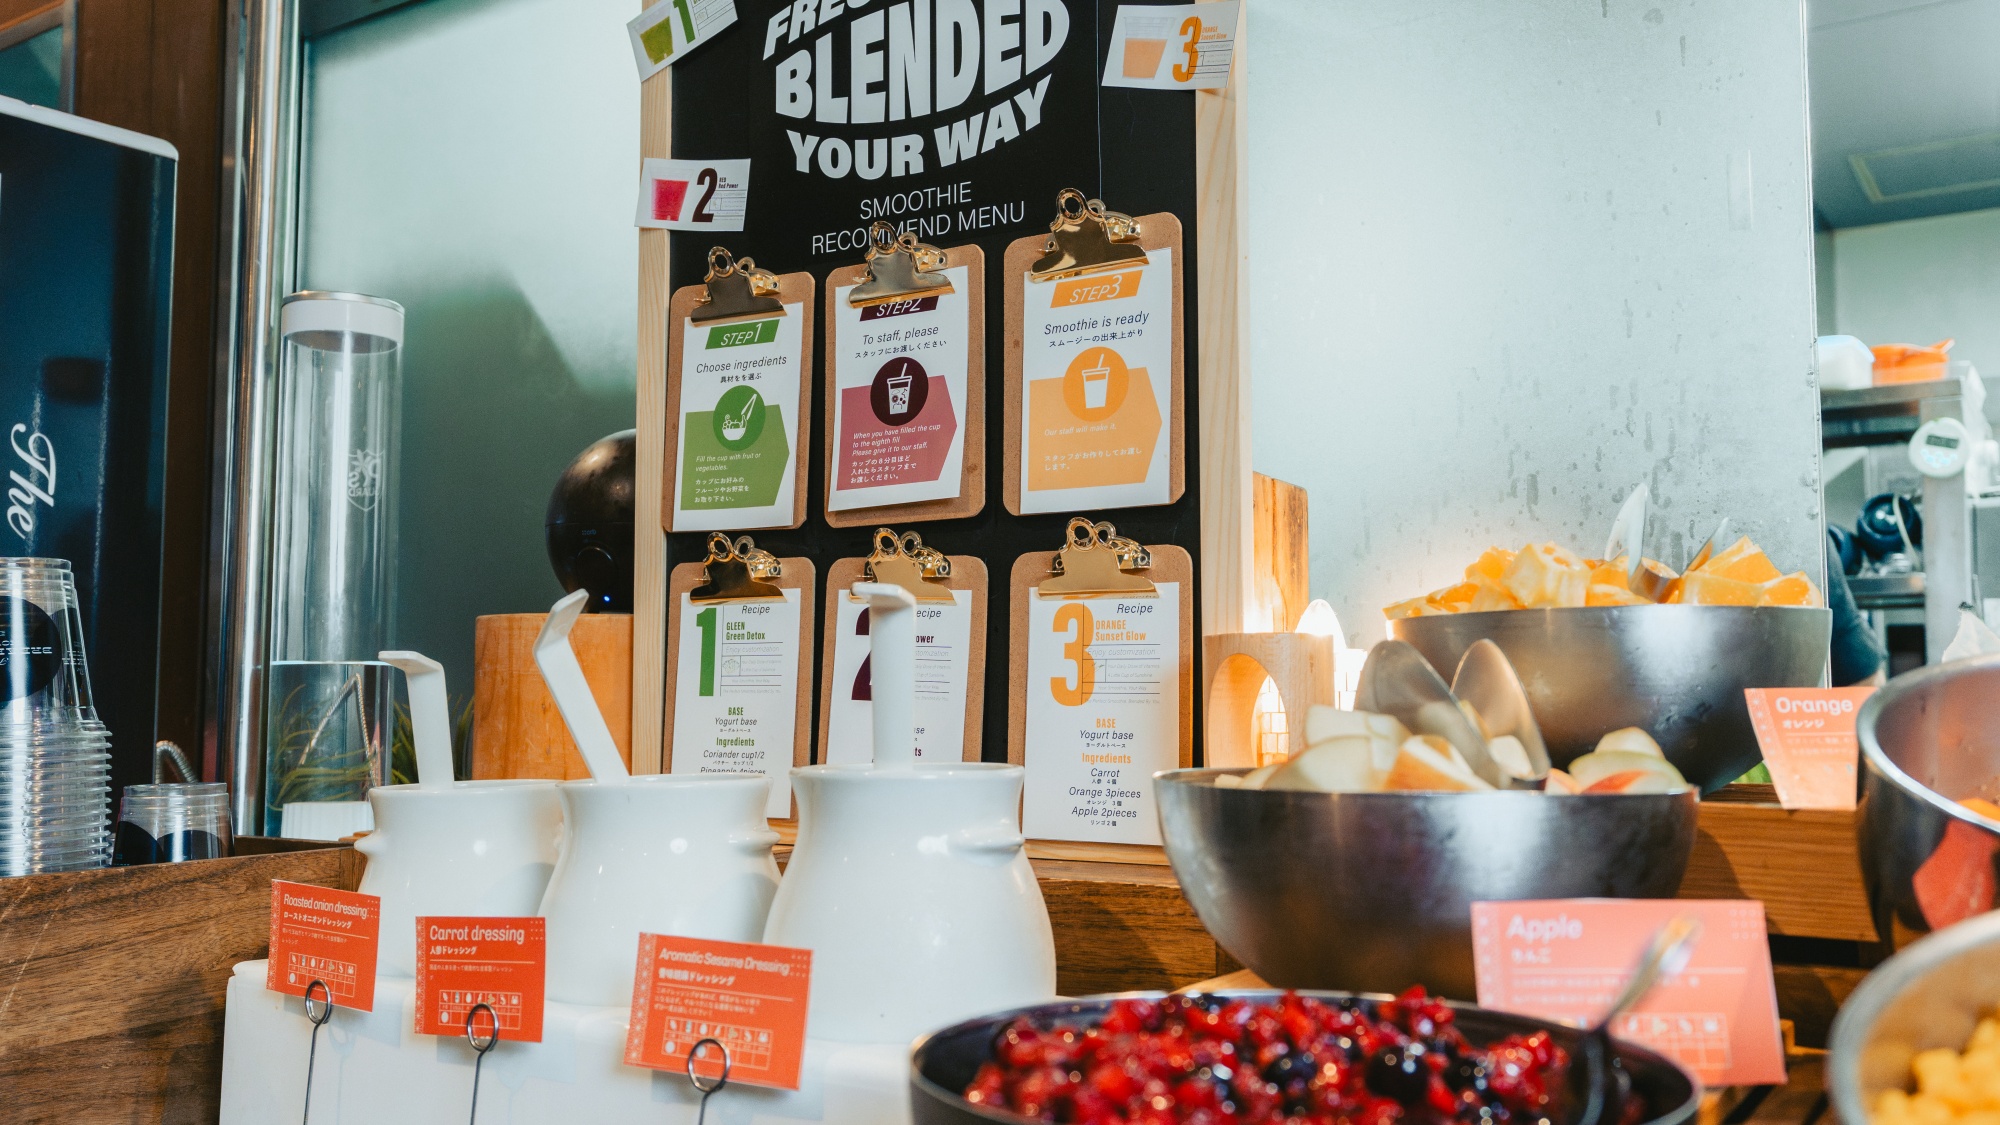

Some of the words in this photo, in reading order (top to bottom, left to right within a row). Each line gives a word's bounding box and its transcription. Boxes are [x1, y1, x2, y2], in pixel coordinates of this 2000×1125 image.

[763, 0, 871, 60] FRE
[1172, 16, 1202, 82] 3
[776, 0, 1069, 124] BLENDED
[786, 129, 924, 180] YOUR
[934, 73, 1052, 168] WAY
[692, 168, 717, 222] 2
[860, 181, 972, 220] SMOOTHIE
[958, 201, 1025, 231] MENU
[1069, 274, 1122, 304] STEP3
[1044, 316, 1098, 336] Smoothie
[1101, 316, 1112, 328] is
[1115, 311, 1150, 326] ready
[720, 322, 762, 346] STEP1
[862, 334, 874, 345] To
[877, 329, 902, 344] staff,
[904, 325, 940, 341] please
[1049, 328, 1143, 348] スムージーの出来上がり
[696, 361, 731, 374] Choose
[734, 354, 787, 372] ingredients
[873, 448, 887, 456] give
[8, 423, 57, 540] The
[916, 607, 942, 620] ecipe
[726, 621, 745, 631] GLEEN
[1095, 620, 1127, 630] ORANGE
[726, 631, 745, 641] Green
[746, 631, 766, 640] Detox
[916, 634, 934, 644] ower
[1095, 631, 1123, 641] Sunset
[1126, 632, 1146, 641] Glow
[696, 608, 717, 696] 1
[741, 605, 770, 616] Recipe
[1050, 602, 1095, 706] 3
[1117, 604, 1153, 615] Recipe
[728, 707, 744, 716] BASE
[1776, 697, 1853, 716] Orange
[714, 717, 738, 726] Yogurt
[1096, 718, 1116, 728] BASE
[1782, 719, 1824, 729] オレンジ
[716, 737, 755, 747] Ingredients
[1079, 730, 1109, 741] Yogurt
[1112, 730, 1134, 740] base
[704, 750, 739, 759] Coriander
[741, 751, 765, 760] cup1/2
[1082, 753, 1131, 765] Ingredients
[1090, 768, 1120, 777] Carrot
[1069, 787, 1102, 798] Orange
[1106, 788, 1141, 799] 3pieces
[1071, 806, 1098, 817] Apple
[1101, 808, 1137, 818] 2pieces
[284, 894, 313, 909] Roasted
[314, 899, 334, 912] onion
[334, 901, 368, 919] dressing
[284, 912, 352, 929] ローストオニオンドレッシング
[1507, 913, 1583, 943] Apple
[430, 925, 469, 941] Carrot
[471, 925, 524, 945] dressing
[659, 948, 704, 965] Aromatic
[704, 952, 743, 969] Sesame
[744, 957, 790, 976] Dressing
